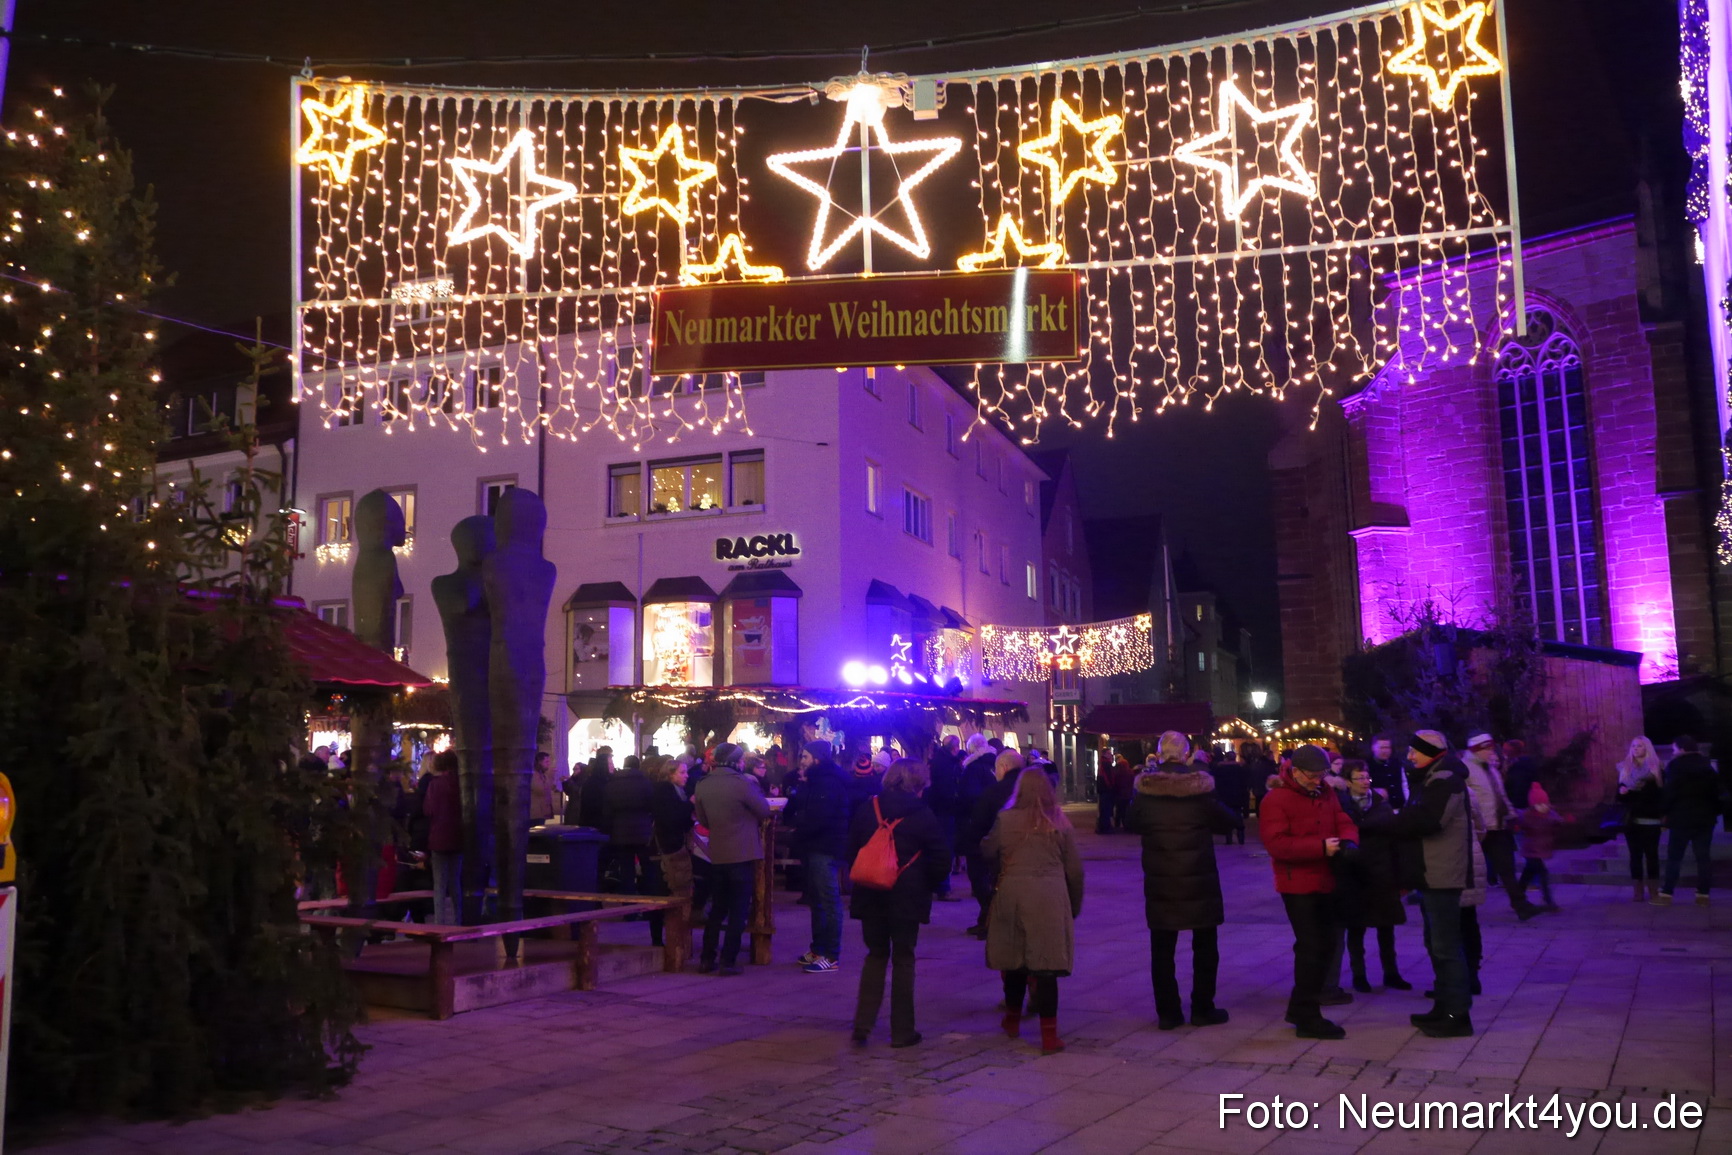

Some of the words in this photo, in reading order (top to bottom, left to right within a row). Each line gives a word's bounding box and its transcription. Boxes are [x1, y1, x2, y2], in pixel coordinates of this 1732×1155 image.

[663, 304, 822, 346] Neumarkter
[828, 293, 1069, 340] Weihnachtsmrkt
[716, 533, 800, 560] RACKL
[746, 558, 792, 570] Rathaus
